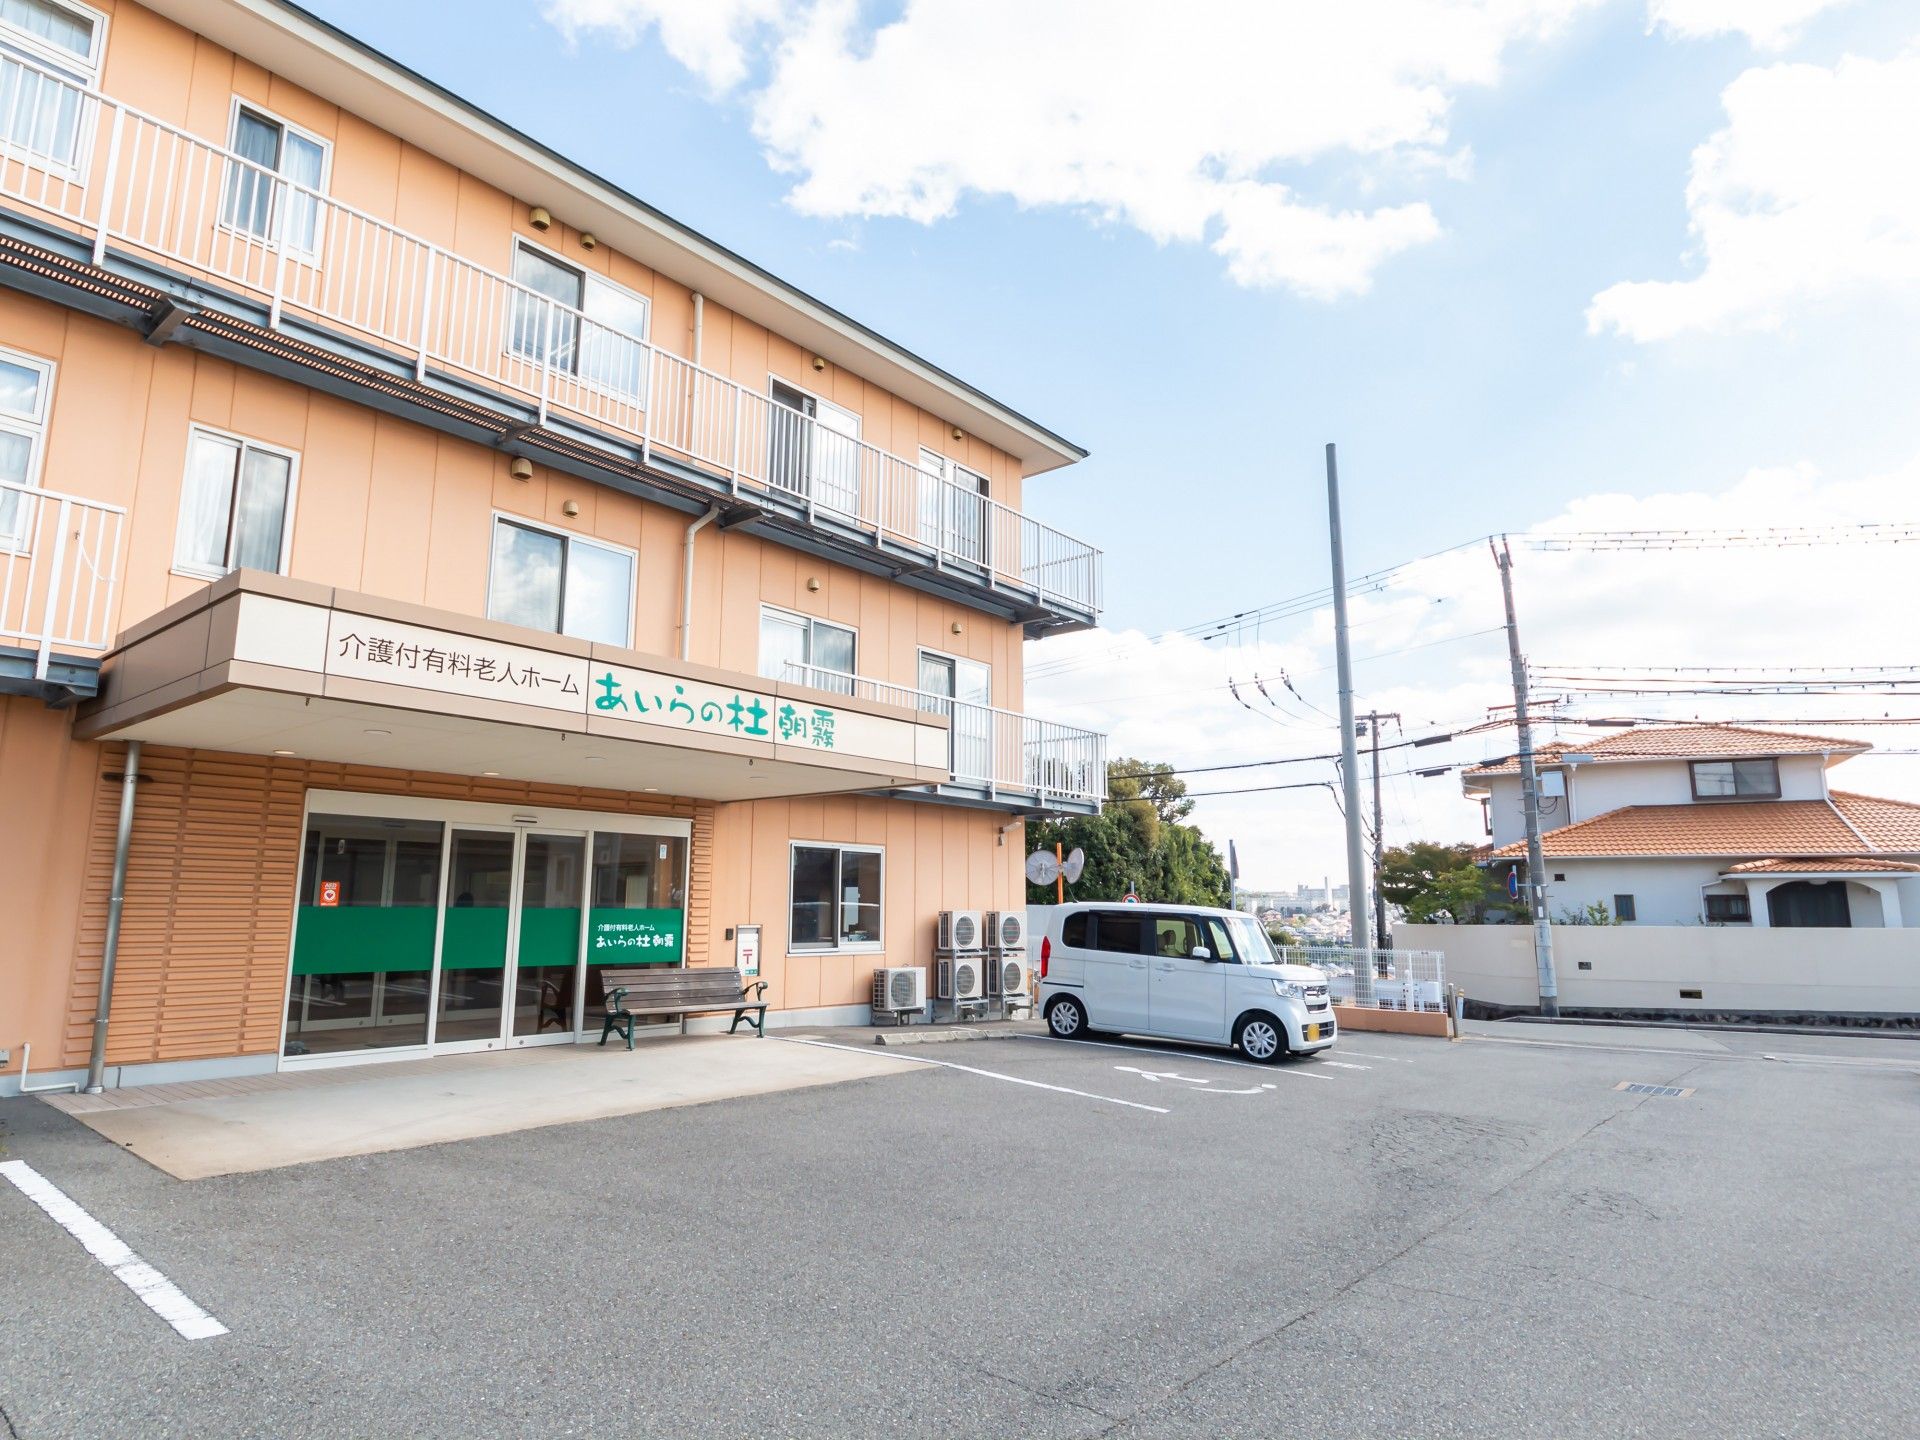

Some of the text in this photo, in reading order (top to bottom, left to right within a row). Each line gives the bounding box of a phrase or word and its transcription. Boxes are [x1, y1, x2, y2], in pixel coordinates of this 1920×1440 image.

[339, 633, 580, 695] 介護付有料老人ホーム
